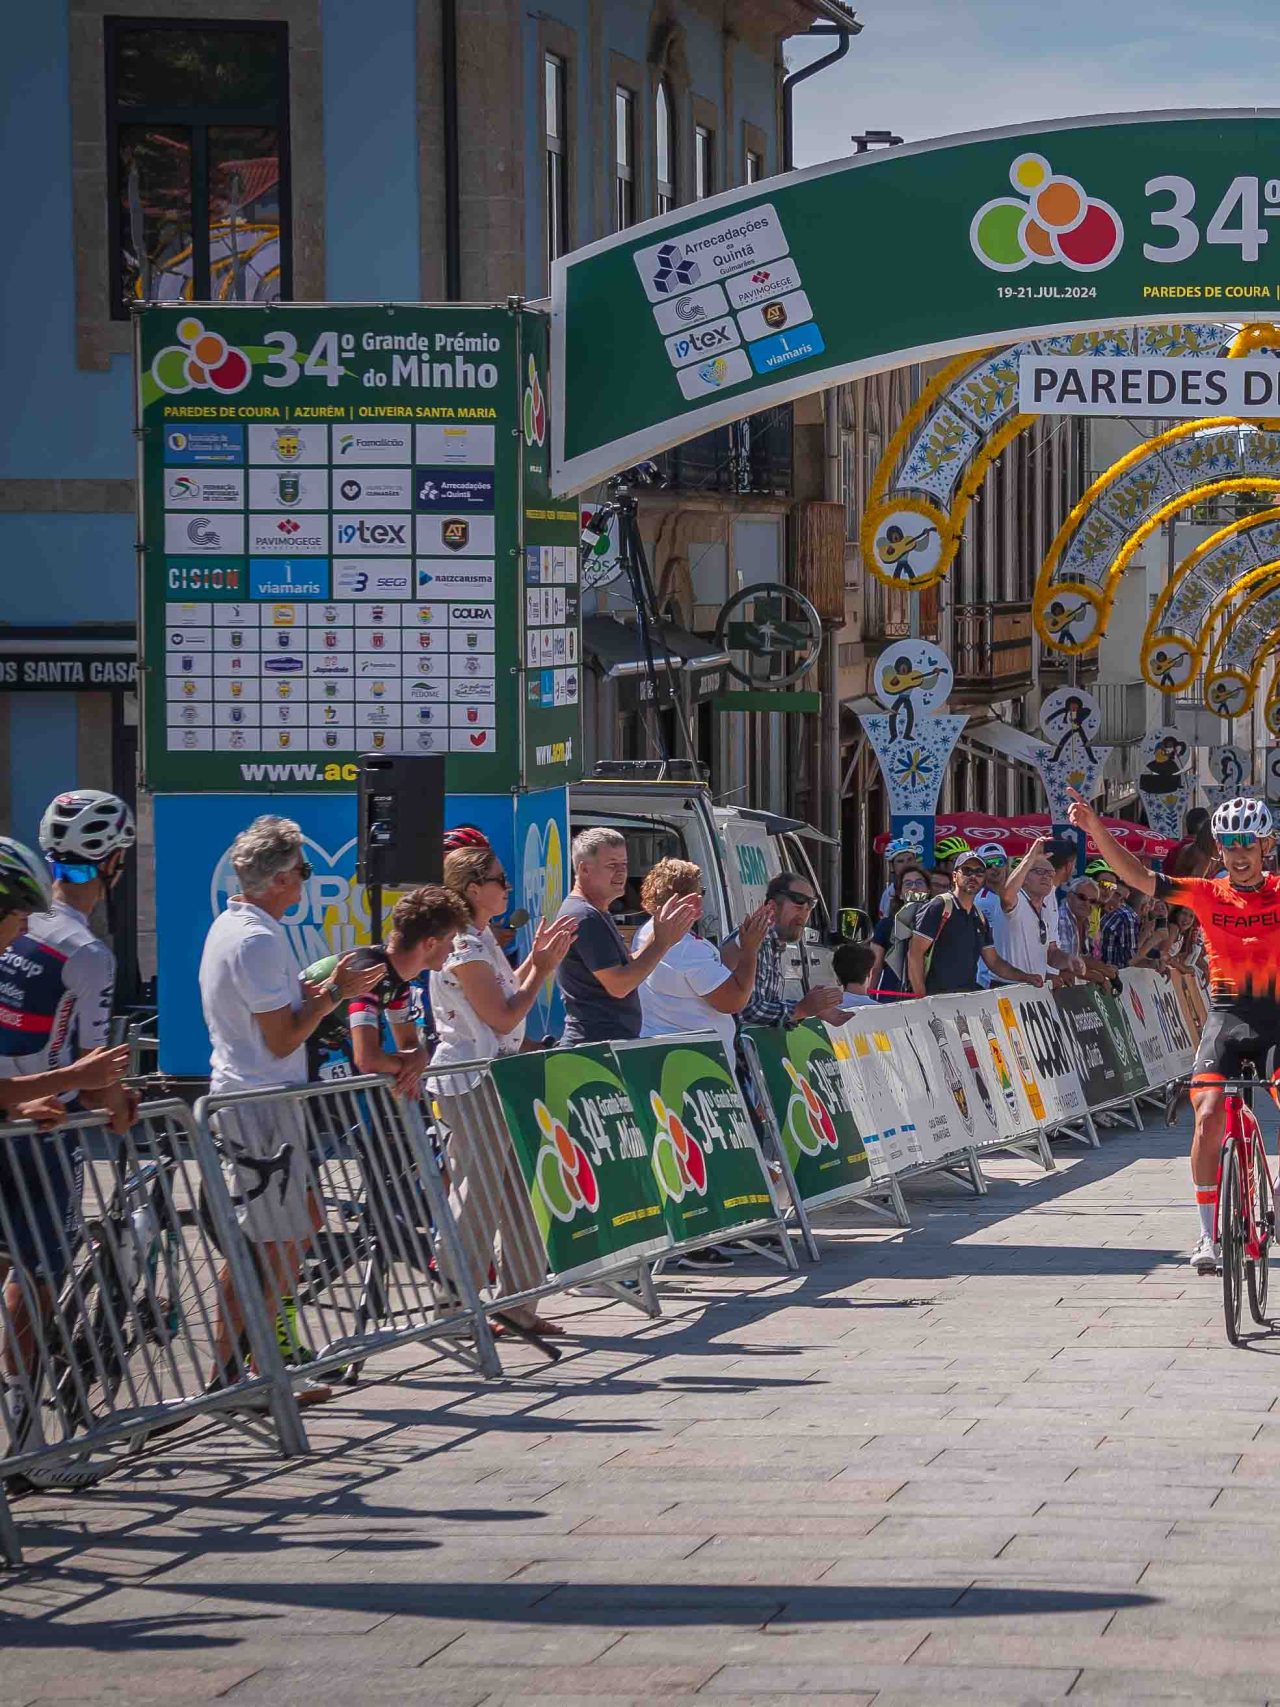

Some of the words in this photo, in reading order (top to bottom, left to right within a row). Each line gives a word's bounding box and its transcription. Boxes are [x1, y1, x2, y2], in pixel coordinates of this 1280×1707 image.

[685, 217, 769, 256] Arrecadações
[712, 244, 755, 267] Quintã
[738, 276, 792, 302] PAVIMOGEGE
[996, 286, 1098, 300] 19-21.JUL.2024
[1143, 286, 1202, 299] PAREDES
[1205, 287, 1223, 298] DE
[1225, 286, 1271, 298] COURA
[362, 331, 429, 352] Grande
[434, 331, 500, 353] Prémio
[263, 331, 355, 388] 34º
[765, 343, 813, 367] viamaris
[363, 368, 387, 388] do
[391, 352, 498, 388] Minho
[1033, 367, 1228, 408] PAREDES
[163, 406, 217, 418] PAREDES
[219, 407, 237, 418] DE
[239, 406, 280, 418] COURA
[294, 404, 345, 417] AZURÉM
[358, 405, 413, 418] OLIVEIRA
[415, 406, 455, 418] SANTA
[457, 407, 497, 419] MARIA
[255, 537, 322, 546] PAVIMOGEGE
[168, 568, 241, 589] CISION
[258, 582, 321, 594] viamaris
[452, 608, 492, 619] COURA
[24, 661, 84, 683] SANTA
[90, 661, 138, 683] CASA
[240, 763, 359, 781] www.ac
[331, 1064, 347, 1080] 63
